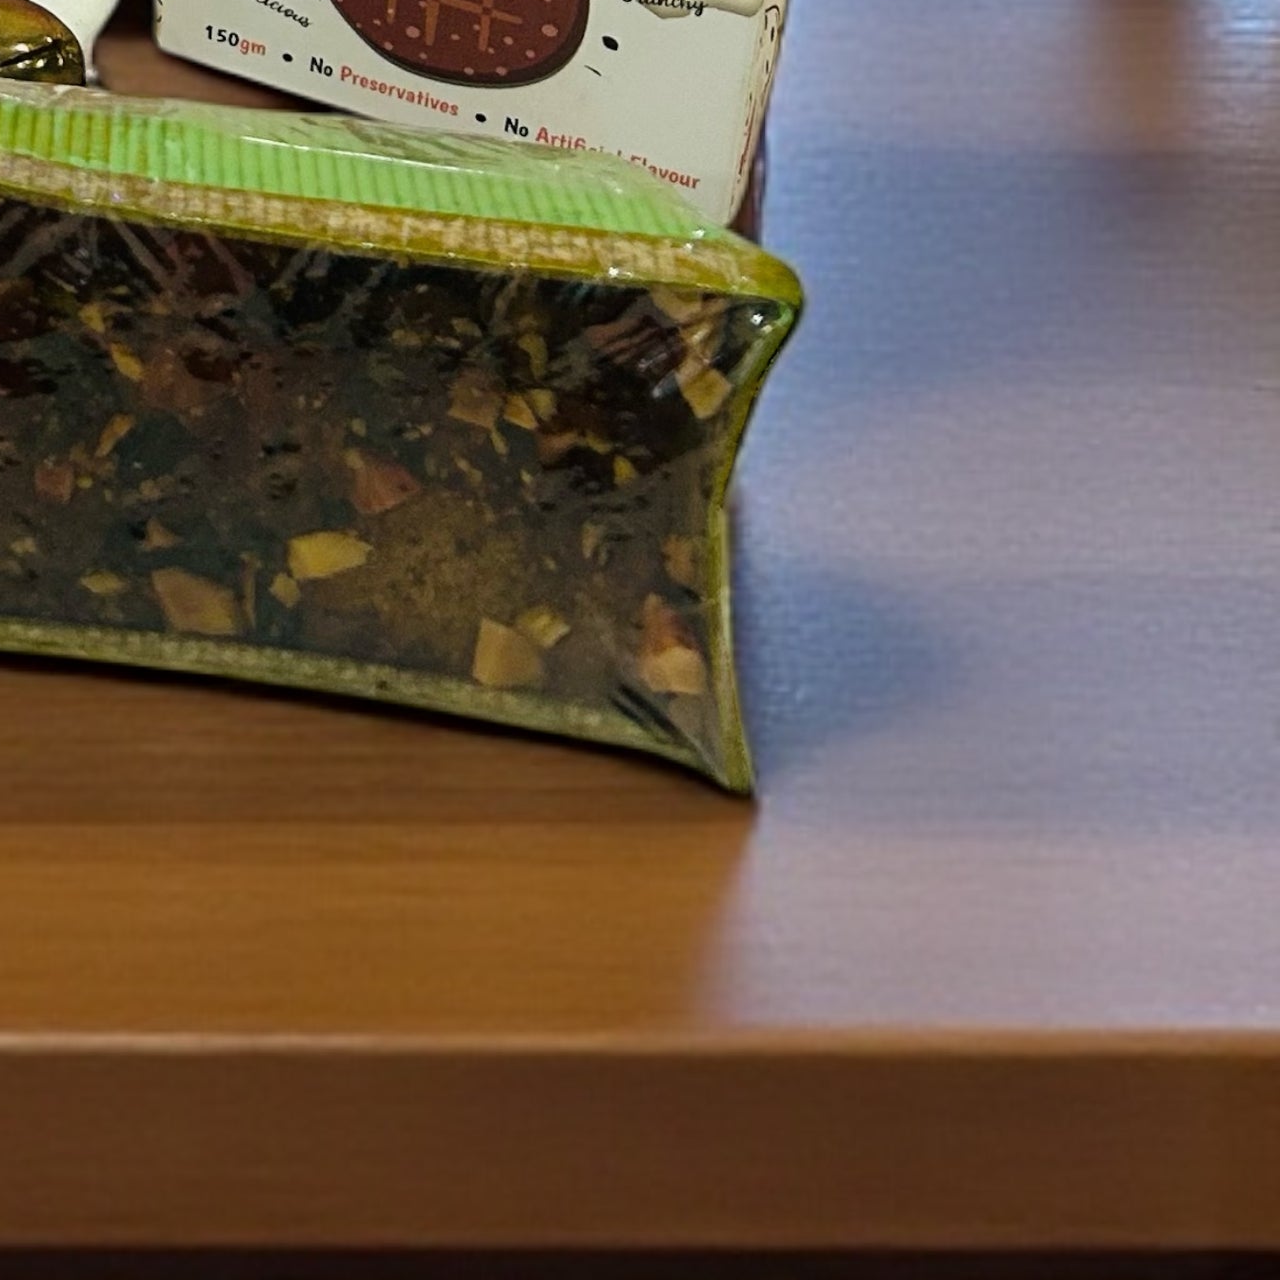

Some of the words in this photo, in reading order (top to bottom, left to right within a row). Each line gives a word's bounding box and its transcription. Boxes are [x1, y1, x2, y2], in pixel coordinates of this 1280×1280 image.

[205, 25, 267, 56] 150gm
[309, 56, 333, 77] No
[340, 65, 460, 116] Preservatives
[504, 116, 529, 137] No
